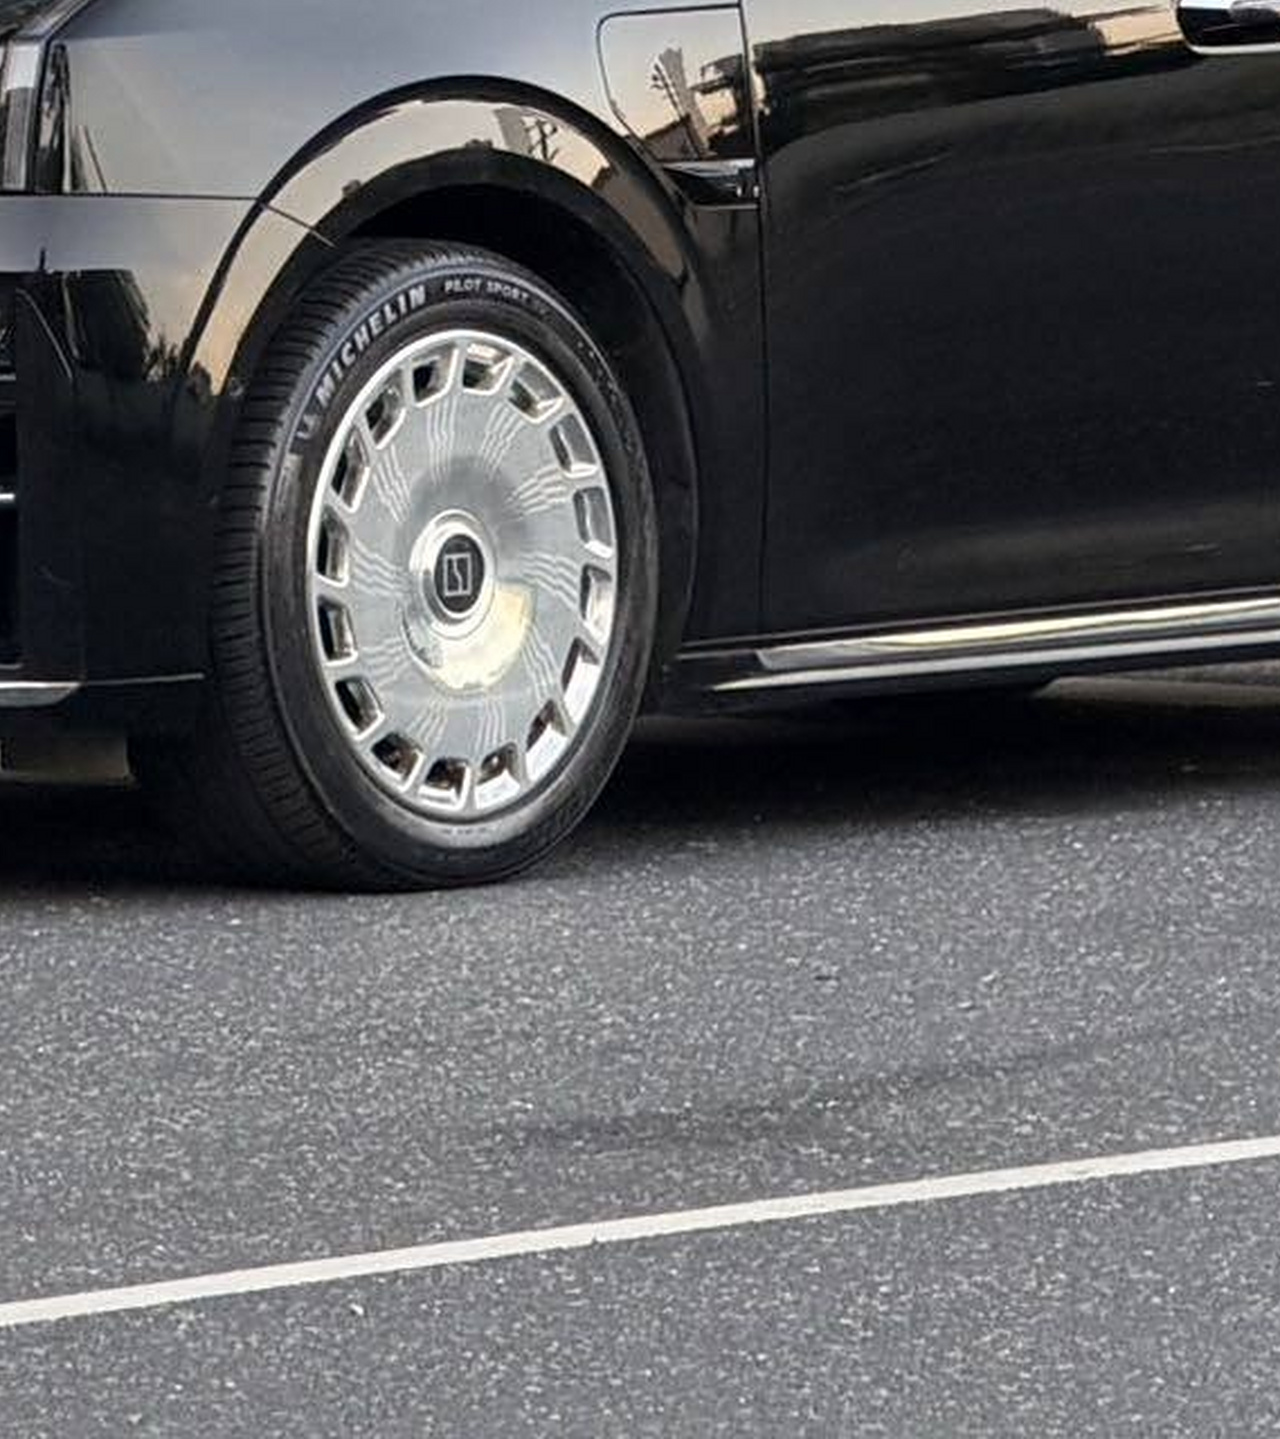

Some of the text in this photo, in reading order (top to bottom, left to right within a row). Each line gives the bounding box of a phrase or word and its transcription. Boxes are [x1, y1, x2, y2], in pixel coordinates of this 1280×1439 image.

[315, 278, 530, 408] MICHELIN PILOT SPORT
